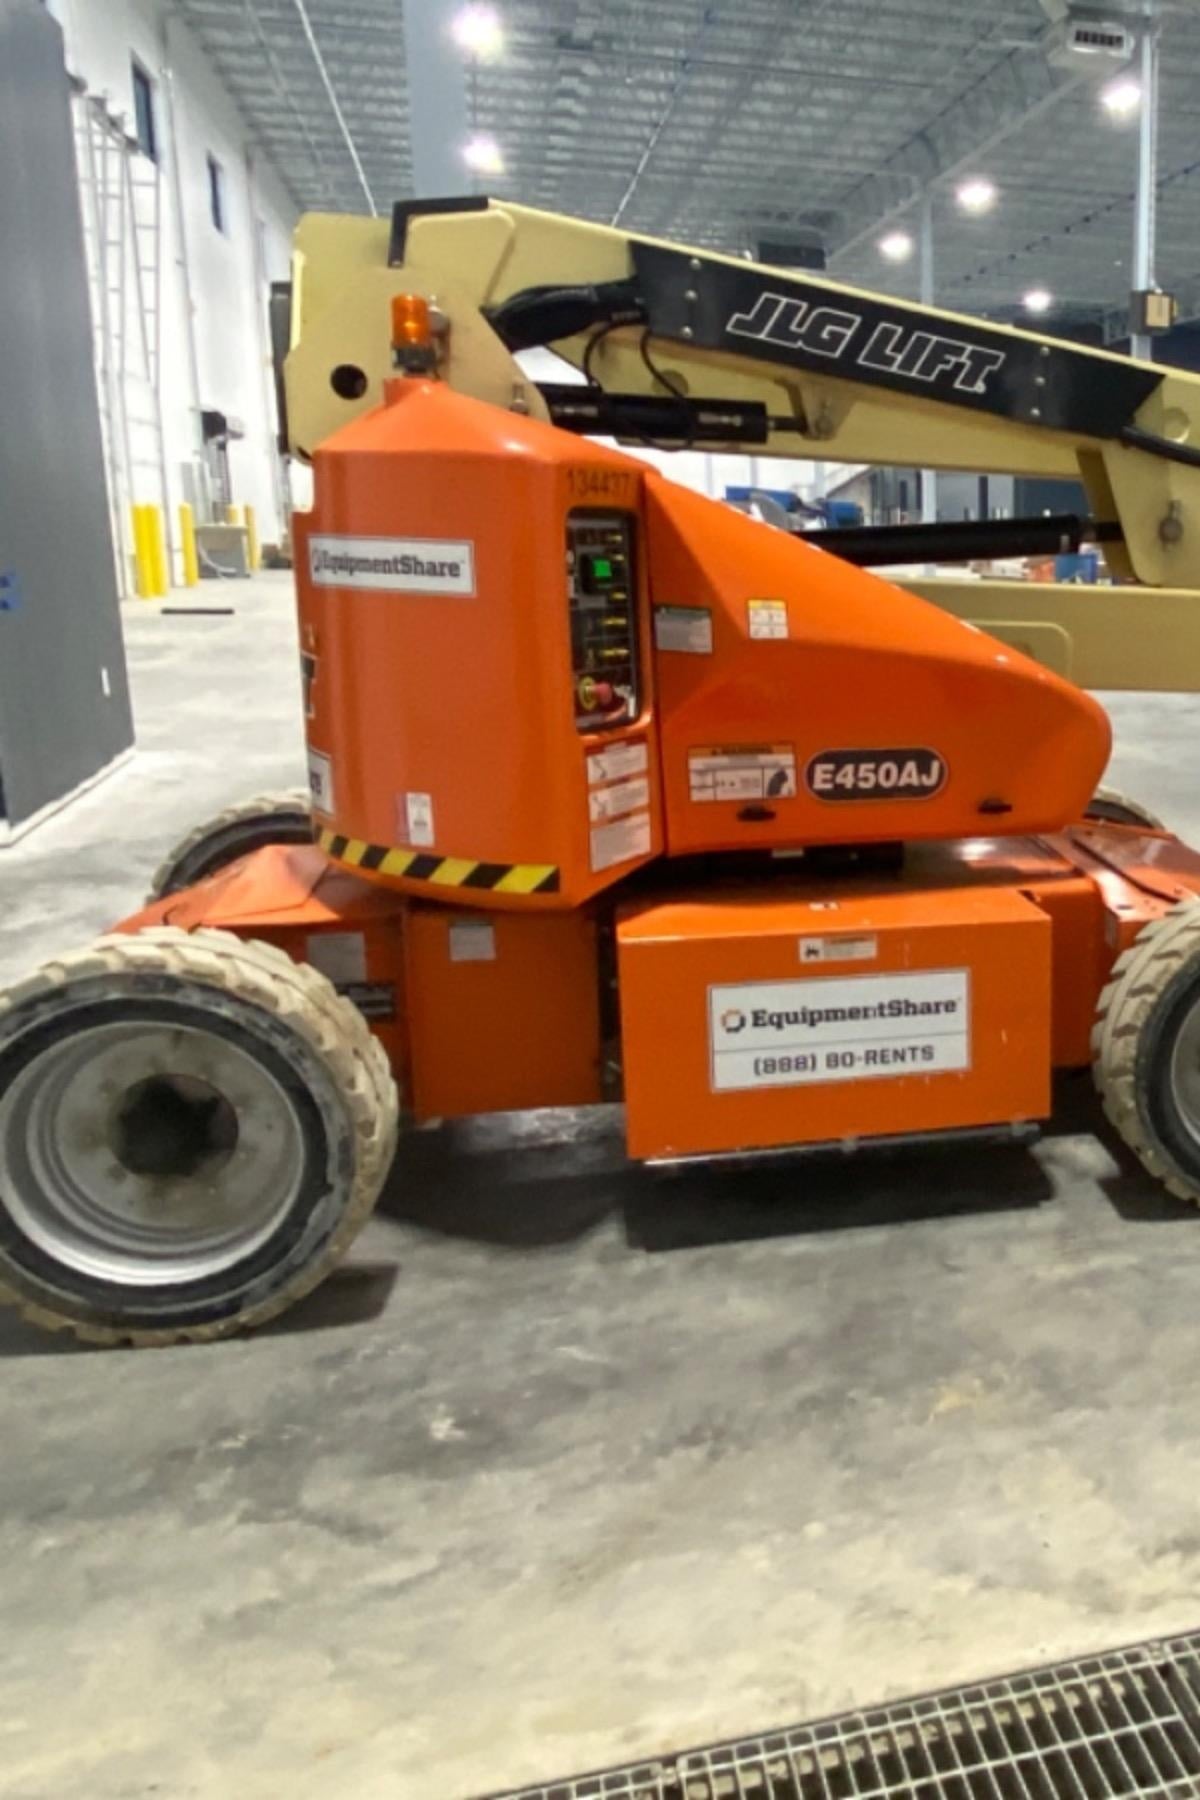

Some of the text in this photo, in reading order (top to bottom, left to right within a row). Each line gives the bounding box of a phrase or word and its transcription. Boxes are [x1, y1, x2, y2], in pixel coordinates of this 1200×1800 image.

[726, 291, 1006, 394] JLG LIFT
[321, 549, 461, 578] EquipmentShare
[812, 760, 942, 791] E450AJ
[751, 998, 958, 1031] EquipmentShare
[753, 1053, 818, 1077] (888)
